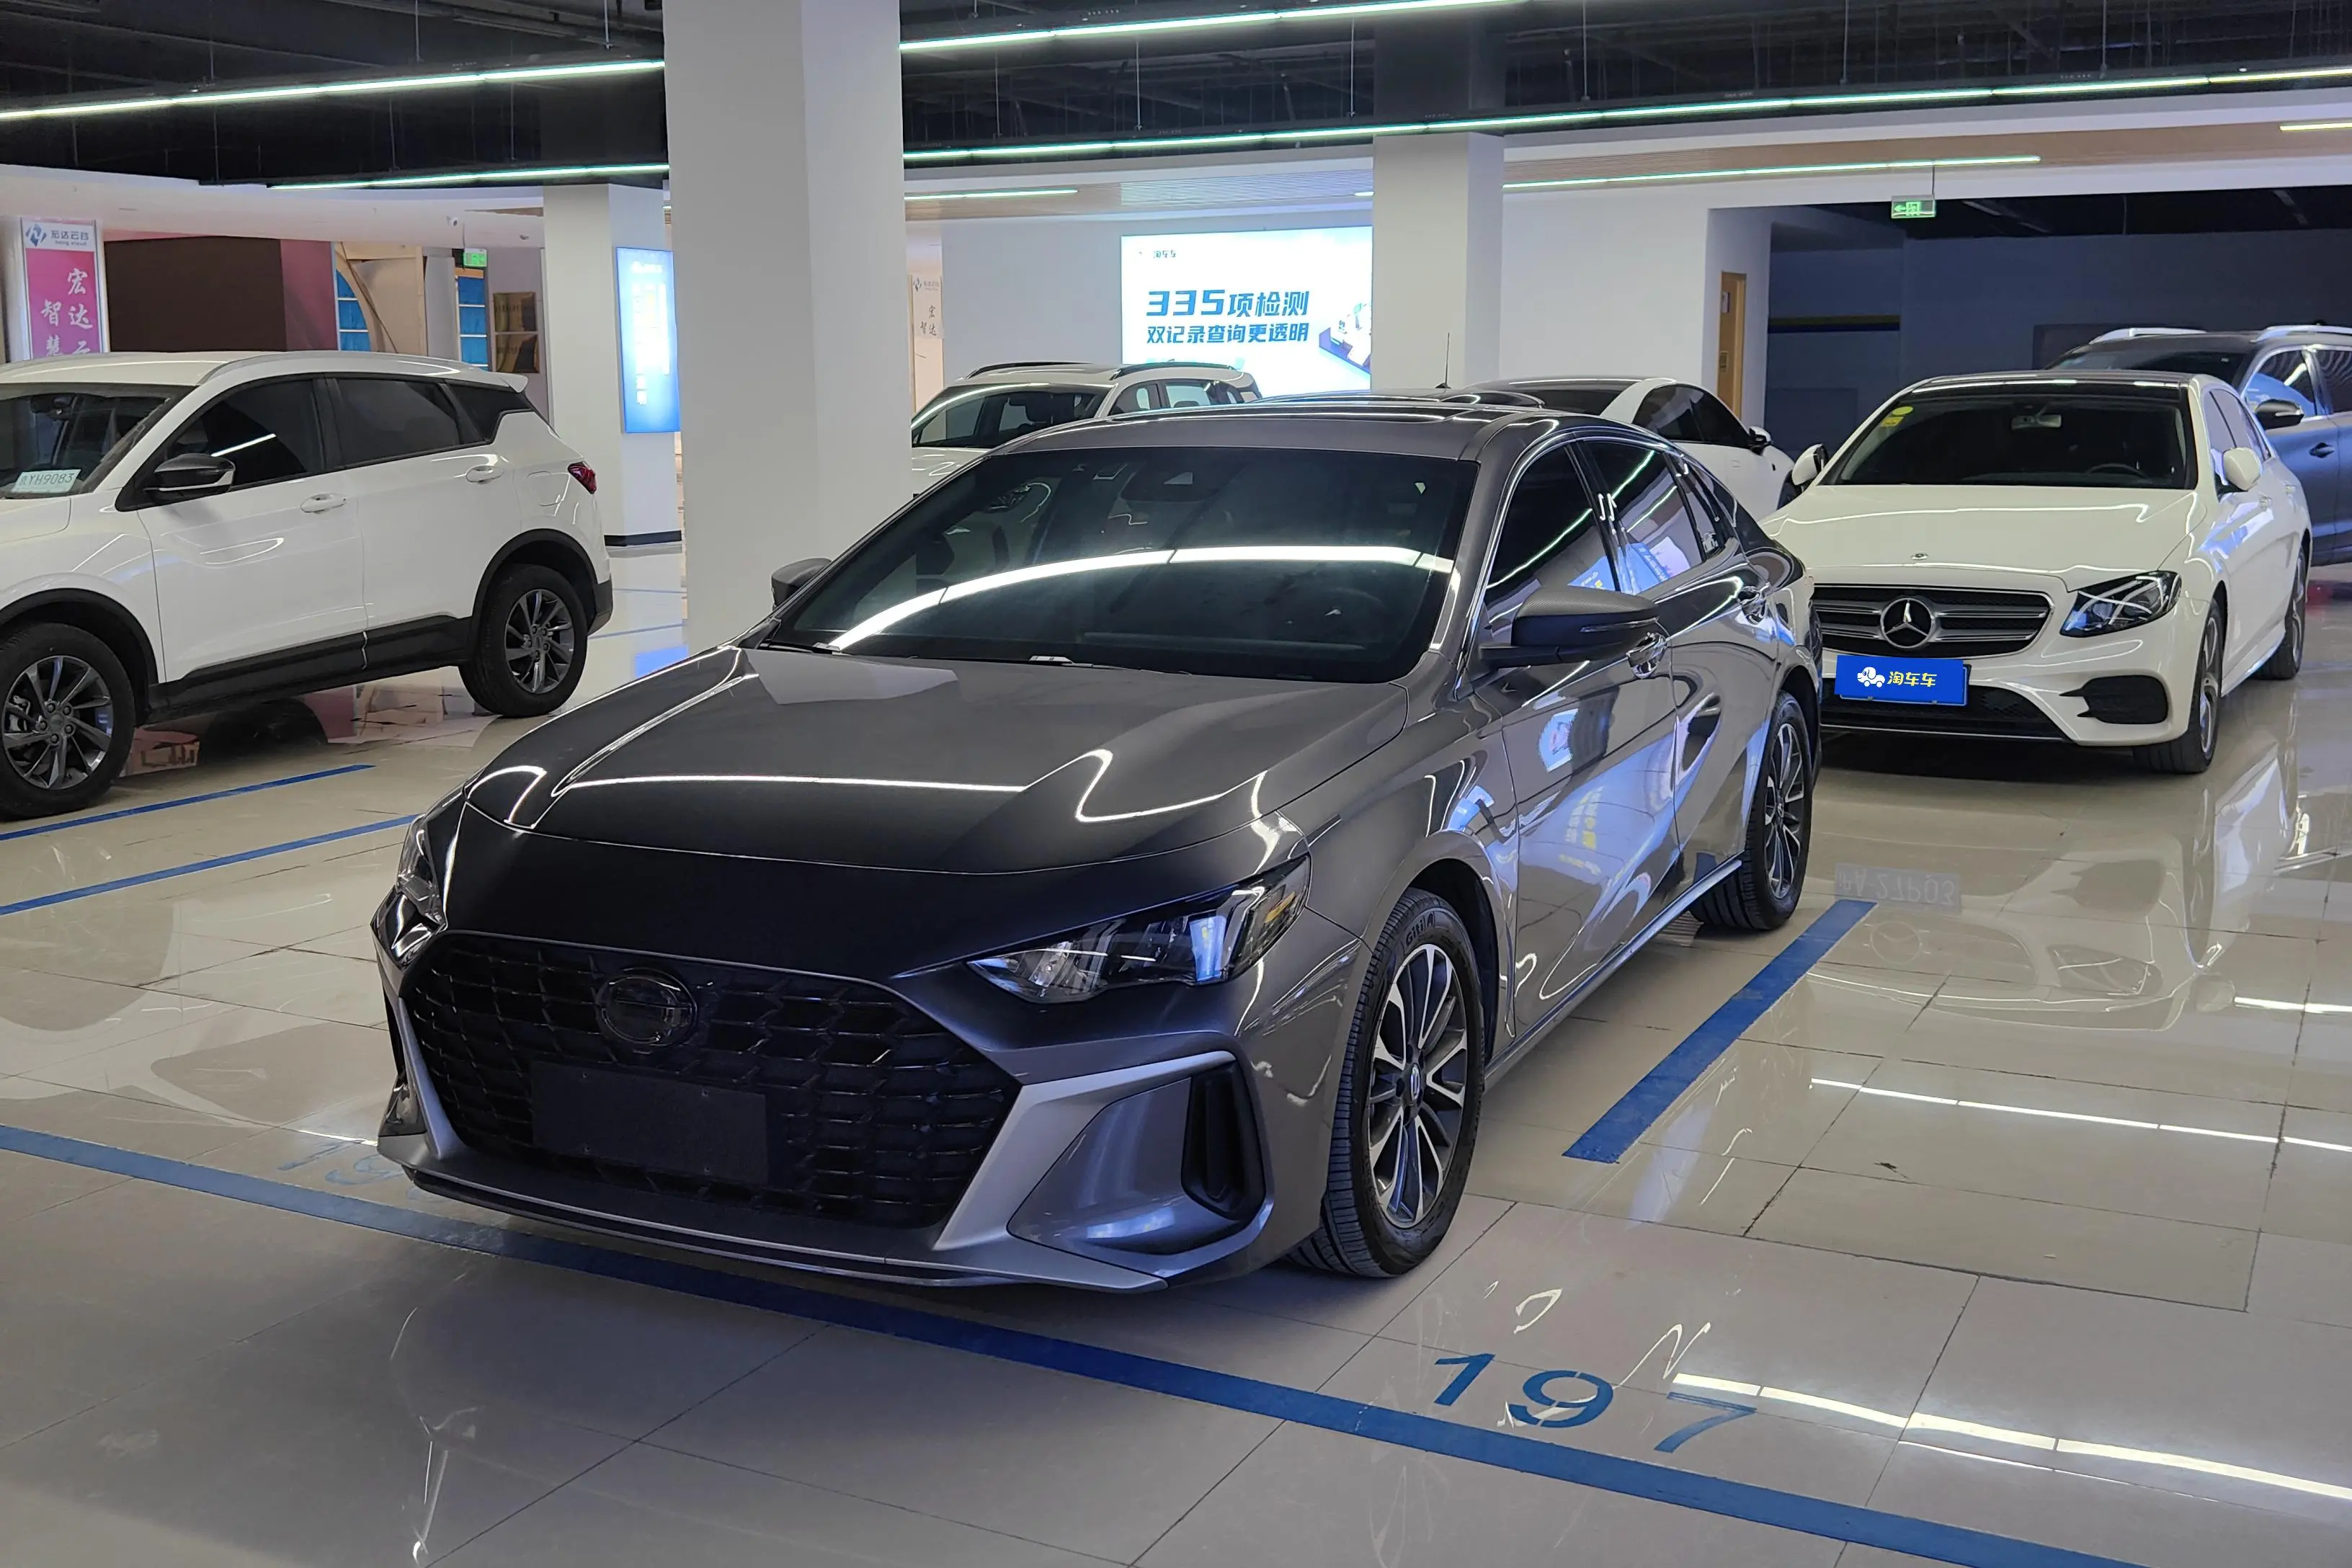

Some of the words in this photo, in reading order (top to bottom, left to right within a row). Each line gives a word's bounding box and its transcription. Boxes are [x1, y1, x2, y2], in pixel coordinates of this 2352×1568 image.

[1146, 289, 1310, 318] 335项检测
[1146, 322, 1310, 344] 双记录查询更透明
[1434, 1353, 1757, 1454] 197
